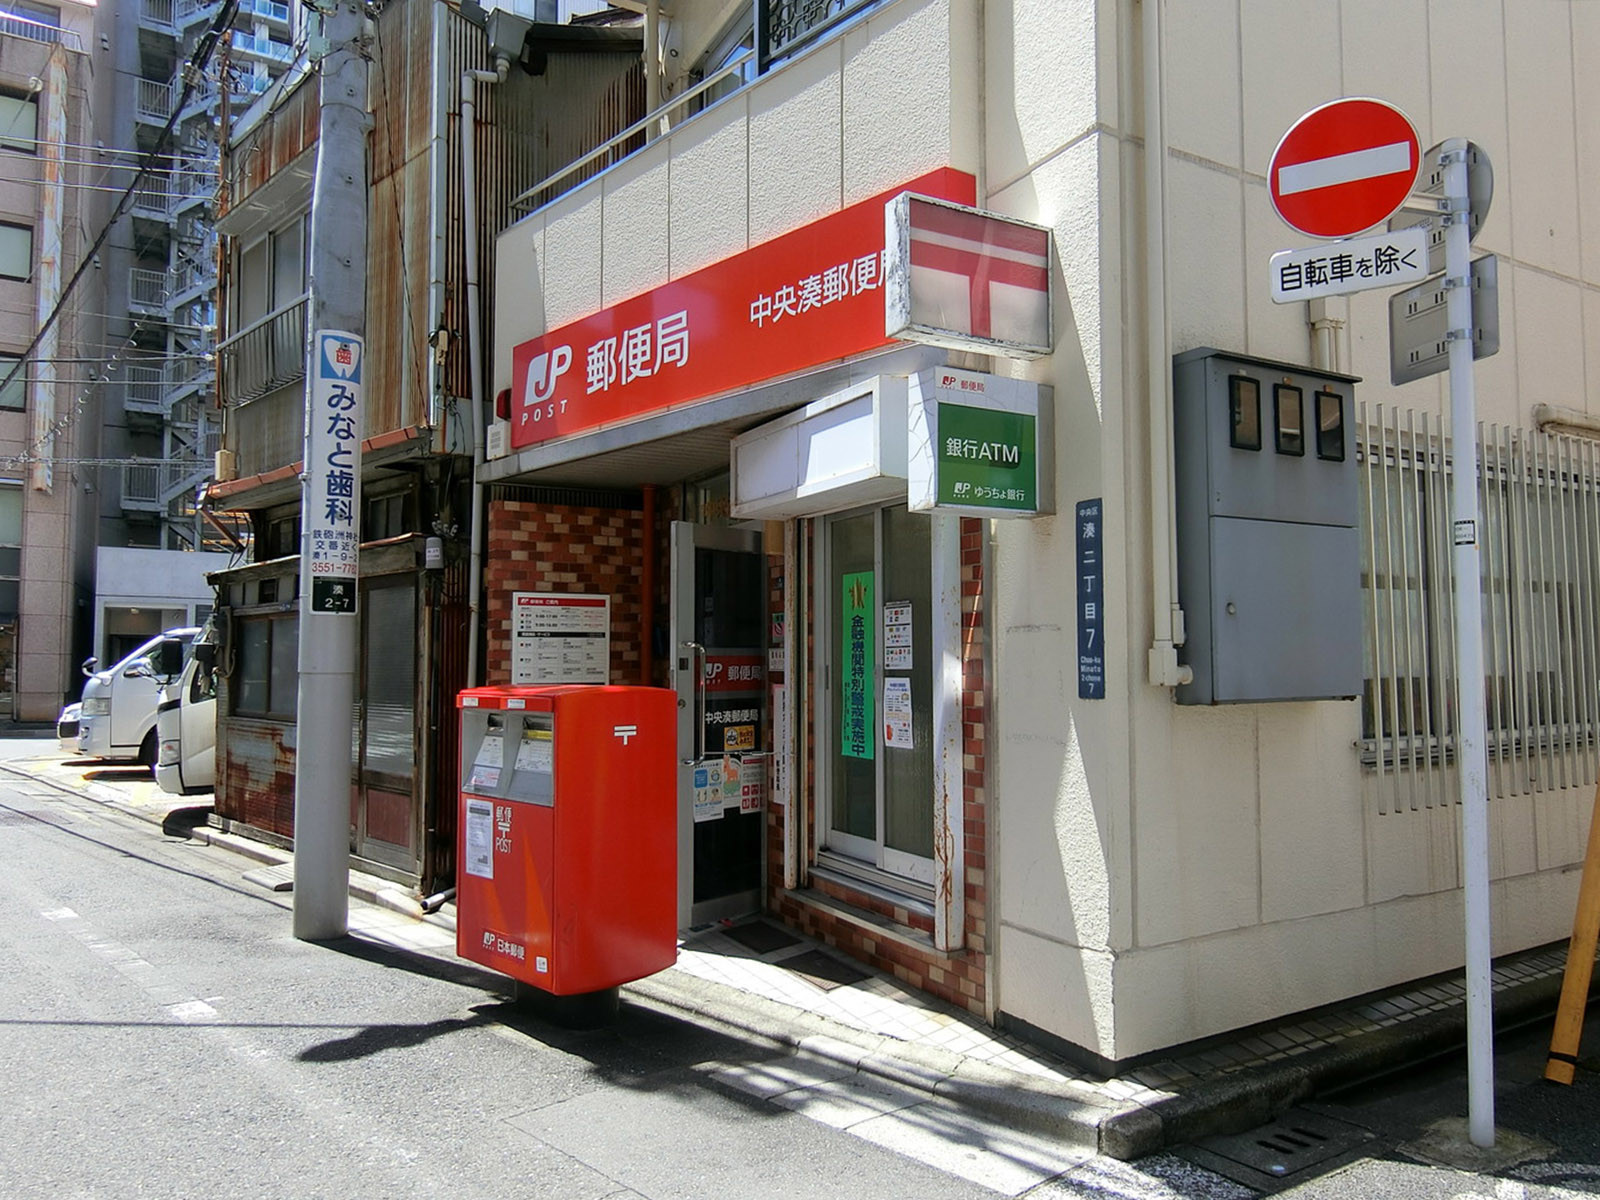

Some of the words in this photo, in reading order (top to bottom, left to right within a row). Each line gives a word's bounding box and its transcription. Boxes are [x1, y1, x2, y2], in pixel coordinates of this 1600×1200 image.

[1280, 245, 1417, 292] 自転車を除く
[586, 309, 689, 395] 郵便局
[521, 399, 567, 426] POST
[324, 383, 357, 527] みなと歯科
[946, 437, 1019, 463] 銀行ATM
[974, 486, 1025, 501] ゆうちょ銀行
[325, 597, 350, 608] 2-7
[727, 665, 761, 681] 郵便局
[851, 614, 865, 756] 金融機関特別警戒実施中
[1088, 682, 1095, 693] 7
[705, 709, 759, 724] 中央湊郵便局
[495, 837, 512, 853] POST
[497, 938, 525, 960] 日本郵便
